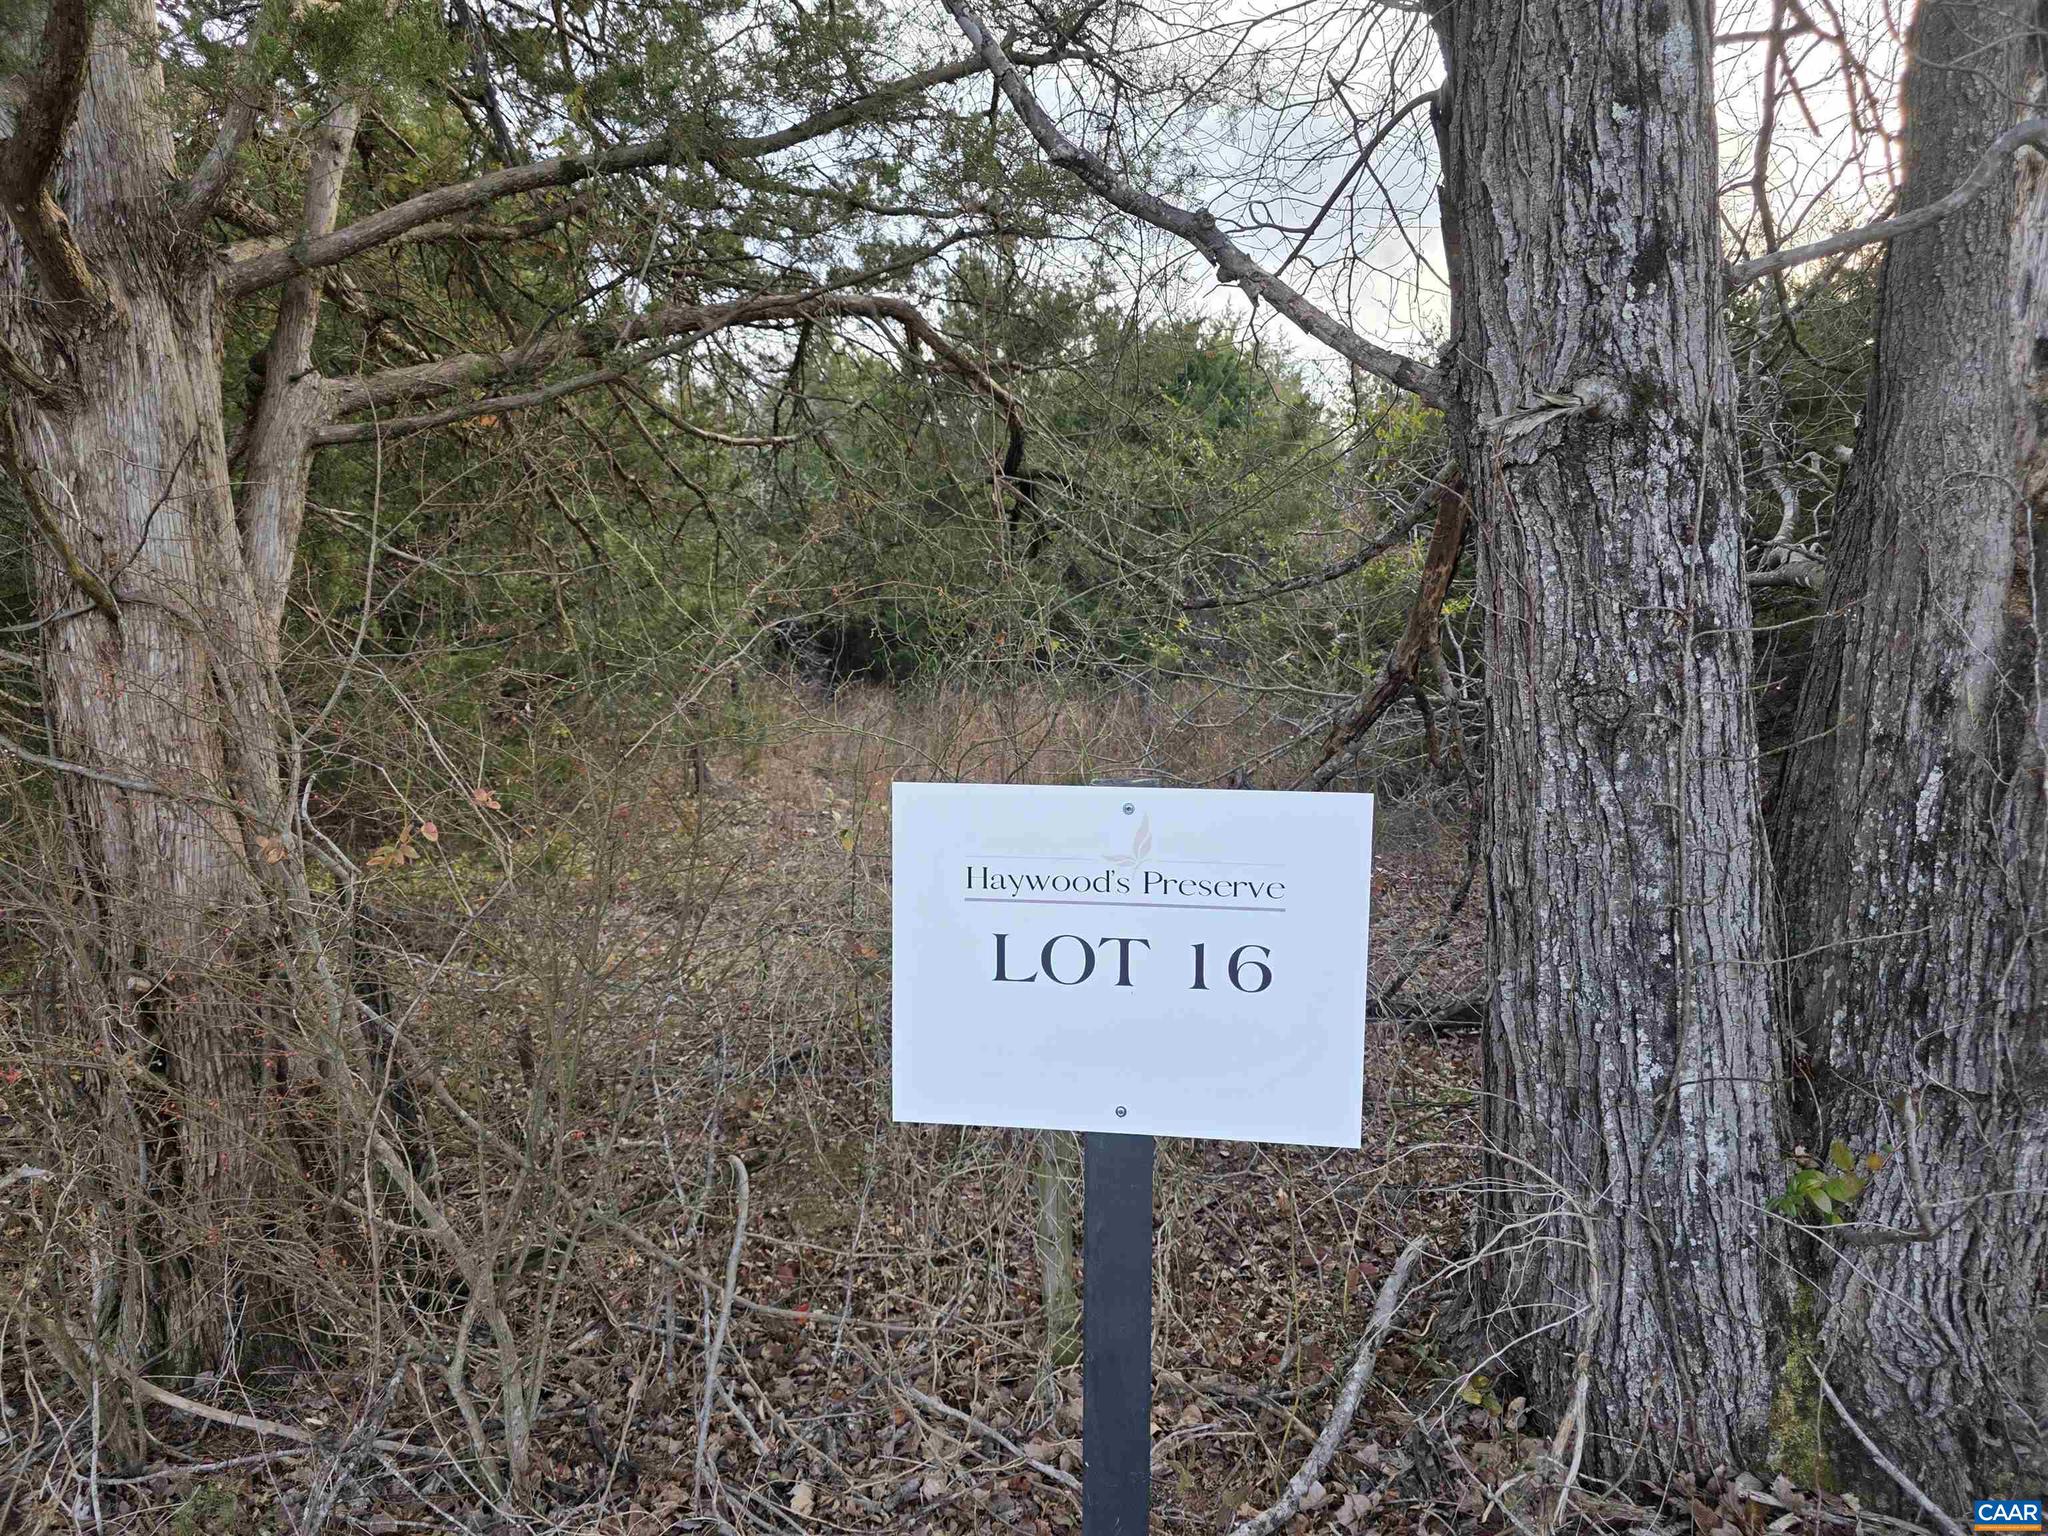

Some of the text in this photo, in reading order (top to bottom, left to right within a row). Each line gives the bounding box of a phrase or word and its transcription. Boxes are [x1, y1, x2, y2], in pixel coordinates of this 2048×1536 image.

[966, 866, 1287, 900] Haywood's Preserve
[993, 933, 1273, 993] LOT 16
